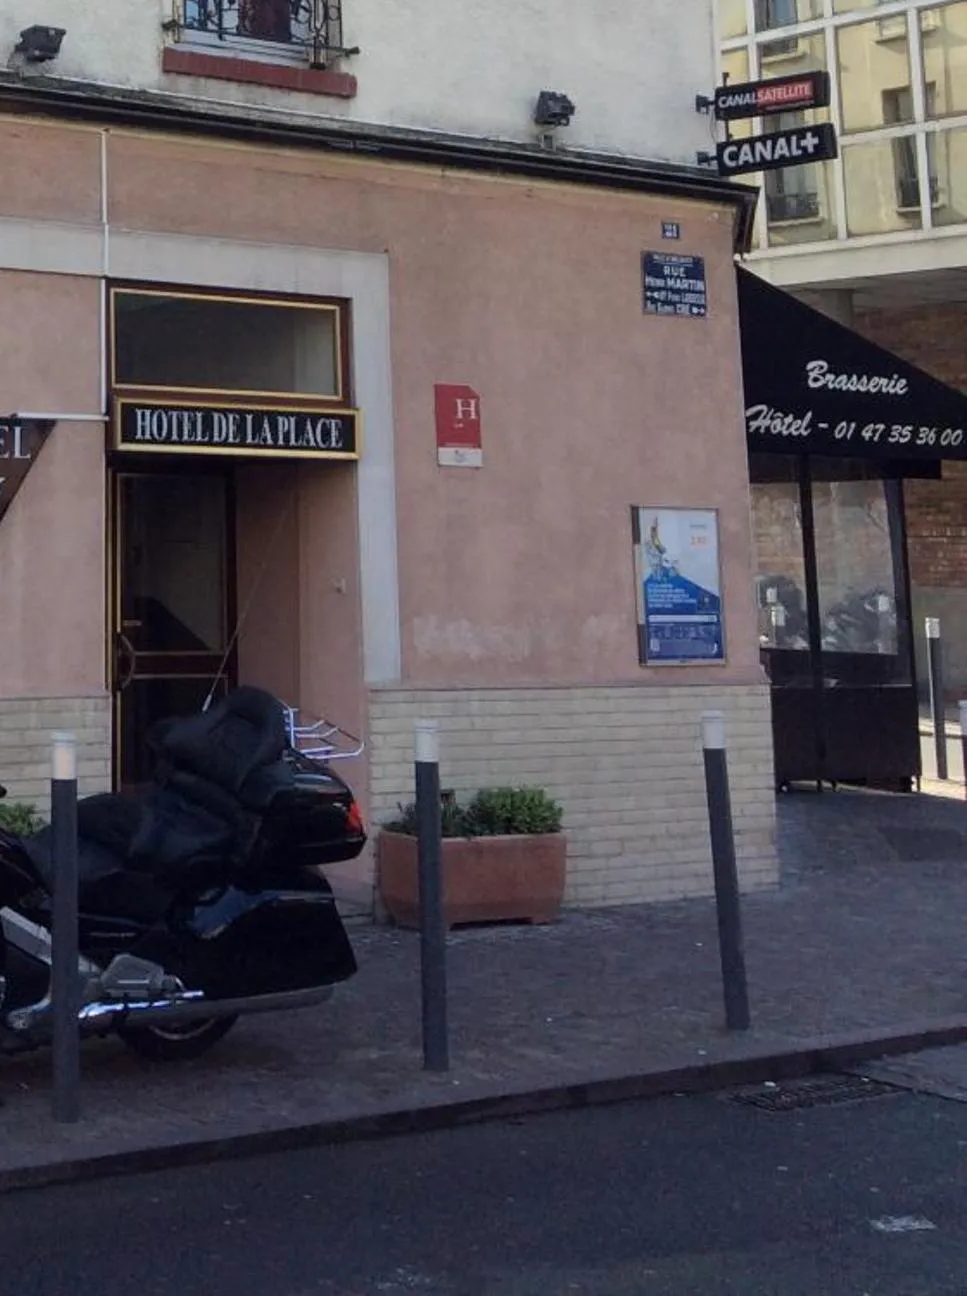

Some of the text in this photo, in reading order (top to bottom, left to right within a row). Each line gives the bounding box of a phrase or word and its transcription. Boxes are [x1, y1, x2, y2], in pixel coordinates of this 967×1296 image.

[722, 131, 819, 168] CANAL+
[662, 265, 687, 278] RUE
[806, 360, 909, 395] Brasserie
[456, 398, 477, 419] H
[746, 405, 812, 436] Hôtel
[834, 421, 856, 440] 01
[861, 423, 885, 442] 47
[888, 424, 912, 443] 35
[916, 427, 937, 446] 36
[940, 428, 964, 446] 00
[135, 408, 344, 448] HOTEL DE LA PLACE
